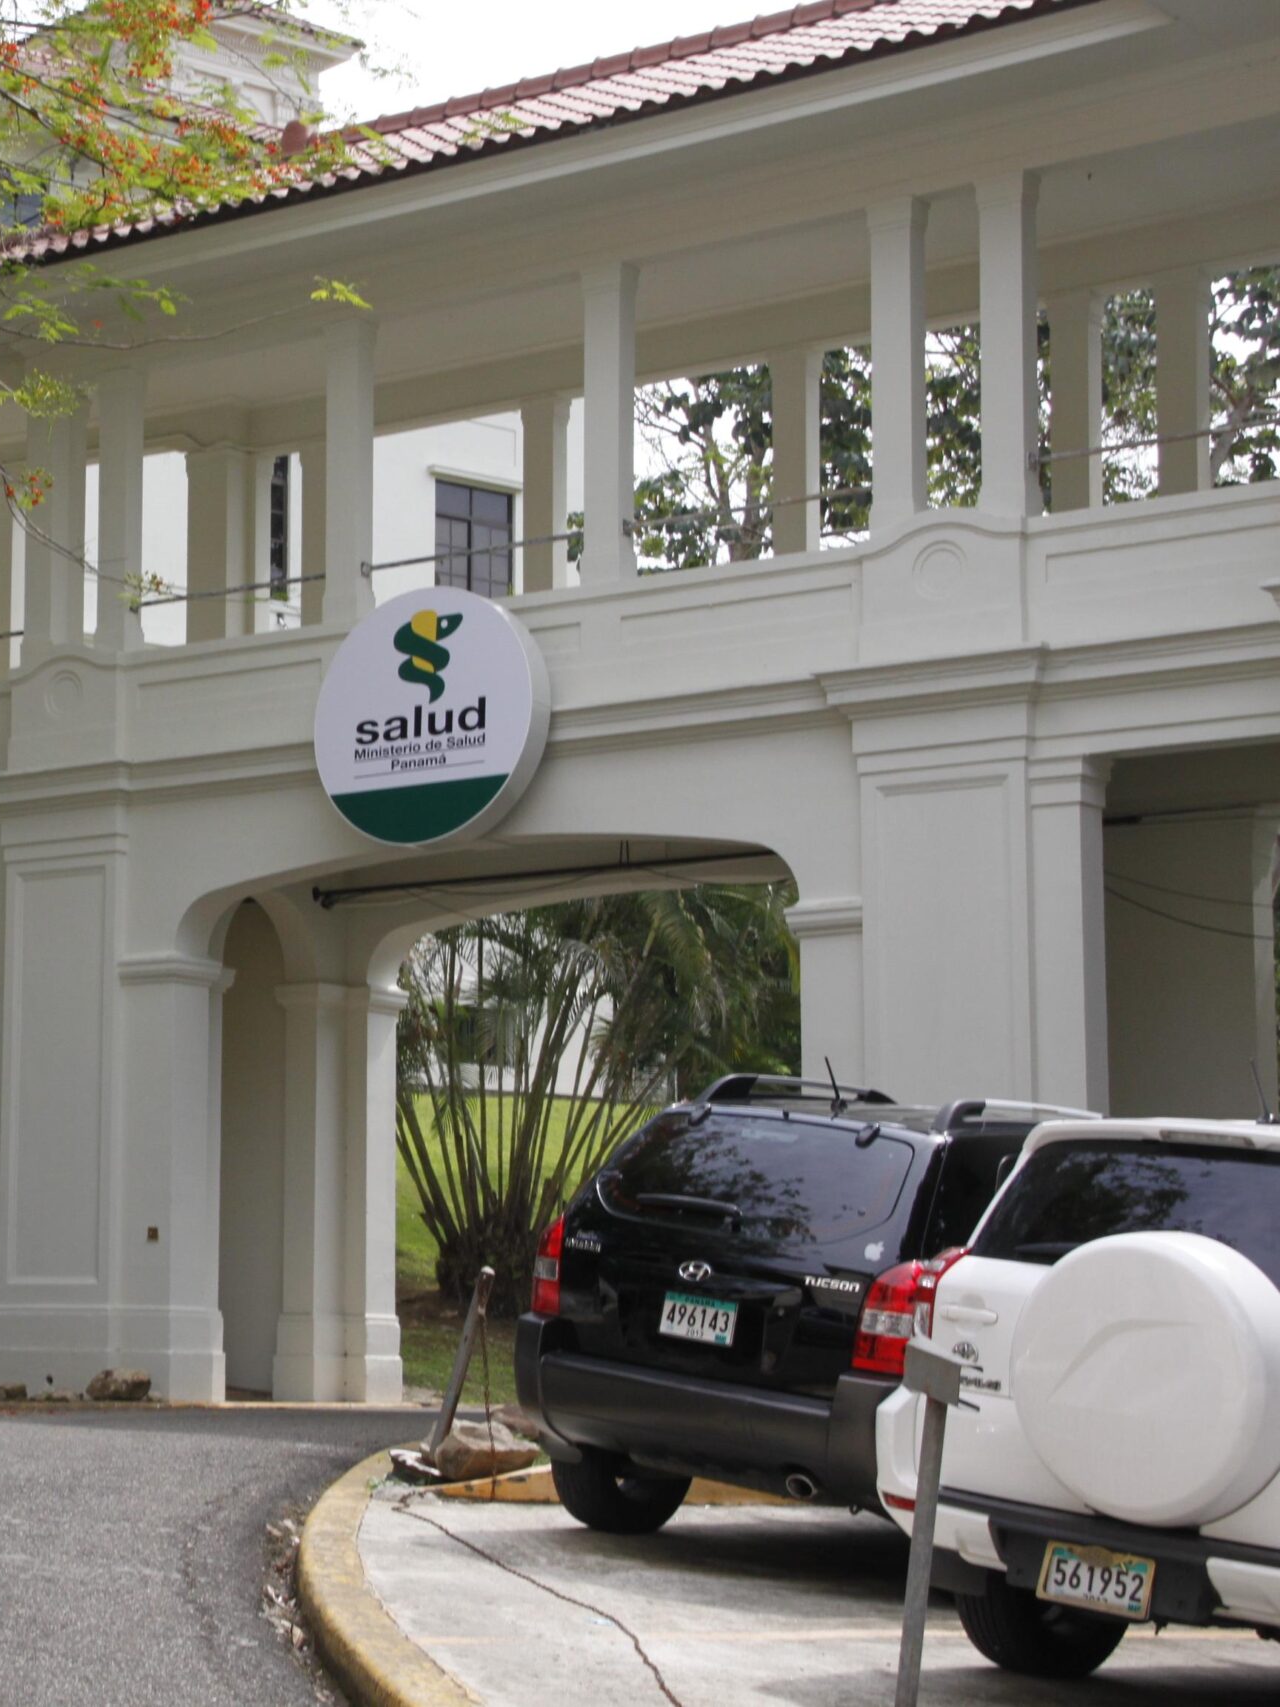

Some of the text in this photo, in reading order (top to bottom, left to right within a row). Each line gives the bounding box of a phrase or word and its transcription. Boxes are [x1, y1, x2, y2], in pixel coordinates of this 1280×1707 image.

[355, 696, 486, 745] salud
[354, 732, 486, 761] Ministerio de Salud
[391, 753, 447, 771] Panamá
[666, 1302, 730, 1333] 496143
[1053, 1557, 1144, 1603] 561952
